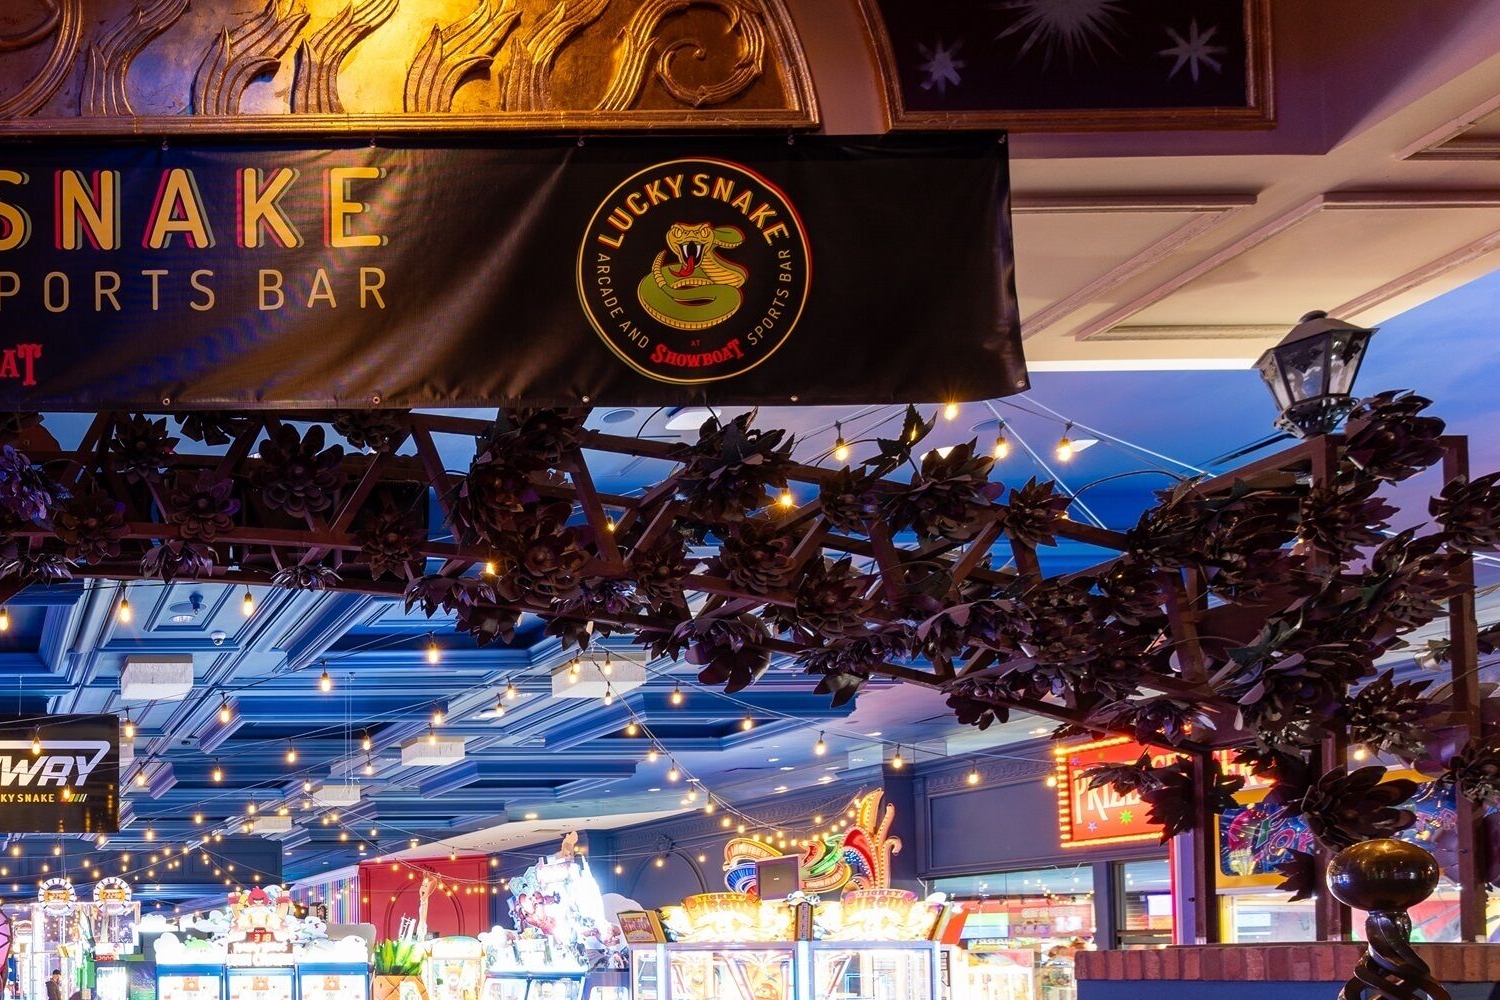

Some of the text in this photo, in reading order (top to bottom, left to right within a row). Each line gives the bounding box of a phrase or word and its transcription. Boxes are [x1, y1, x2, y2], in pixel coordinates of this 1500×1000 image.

[597, 173, 790, 250] LUCKY SNAKE
[259, 266, 387, 310] BAR
[597, 252, 650, 350] ARCADE AND
[747, 249, 792, 346] SPORTS BAR
[650, 338, 745, 367] SHOWBOAT
[17, 793, 55, 803] SNAKE
